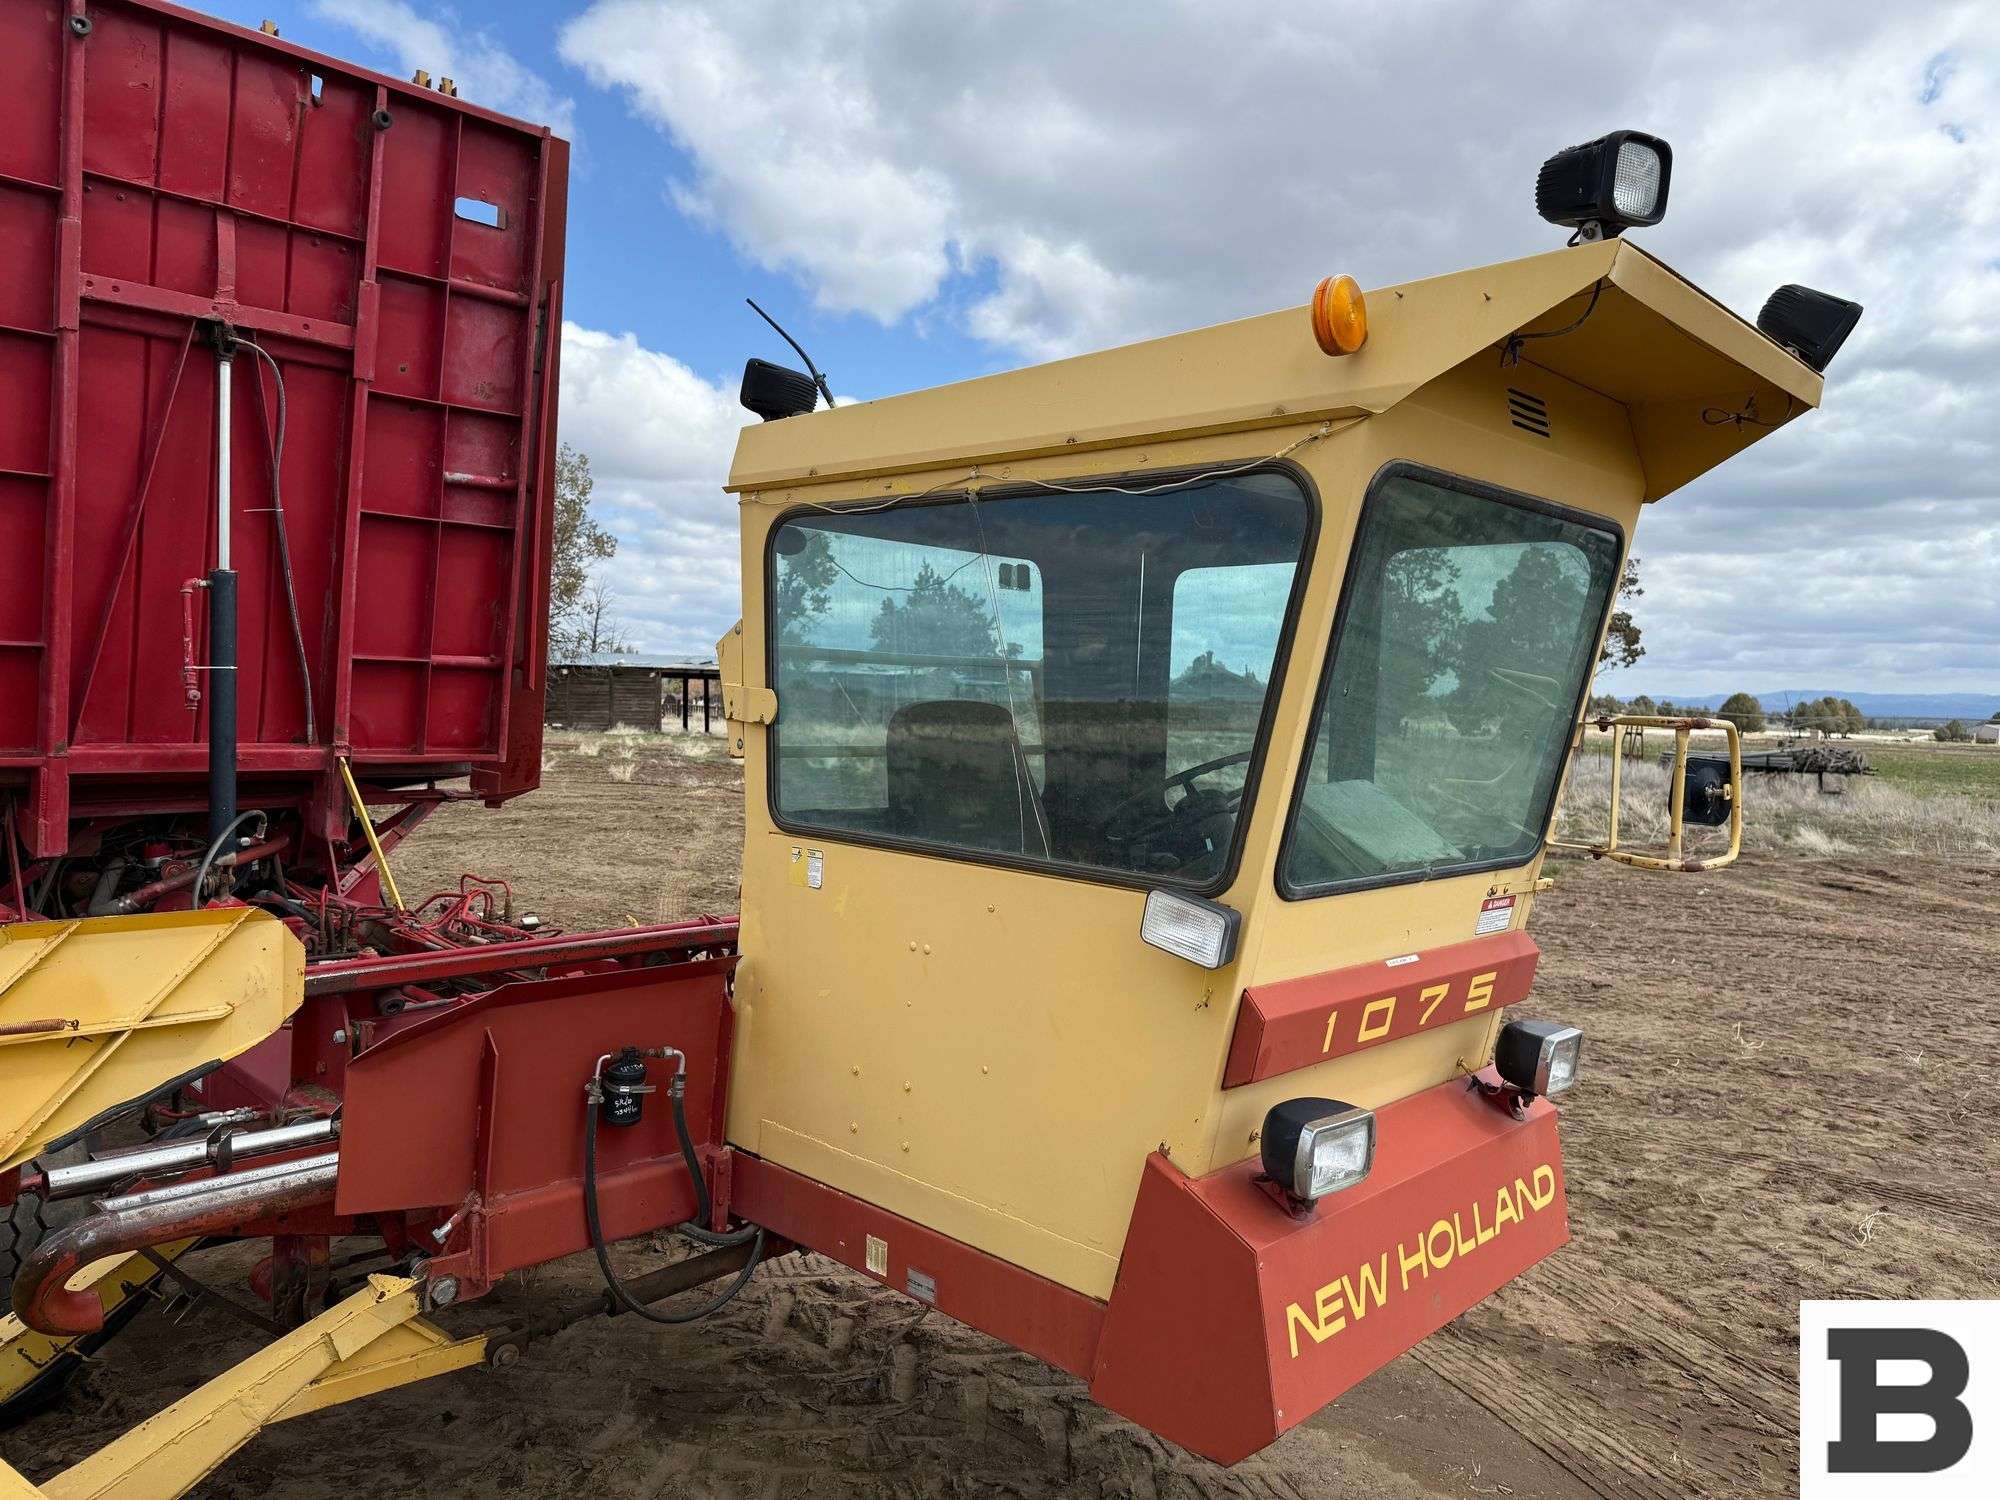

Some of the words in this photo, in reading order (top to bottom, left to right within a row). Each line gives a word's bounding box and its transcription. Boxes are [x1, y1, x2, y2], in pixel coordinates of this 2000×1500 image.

[1321, 971, 1498, 1053] 1075
[1285, 1251, 1388, 1359] NEW
[1397, 1164, 1556, 1291] HOLLAND
